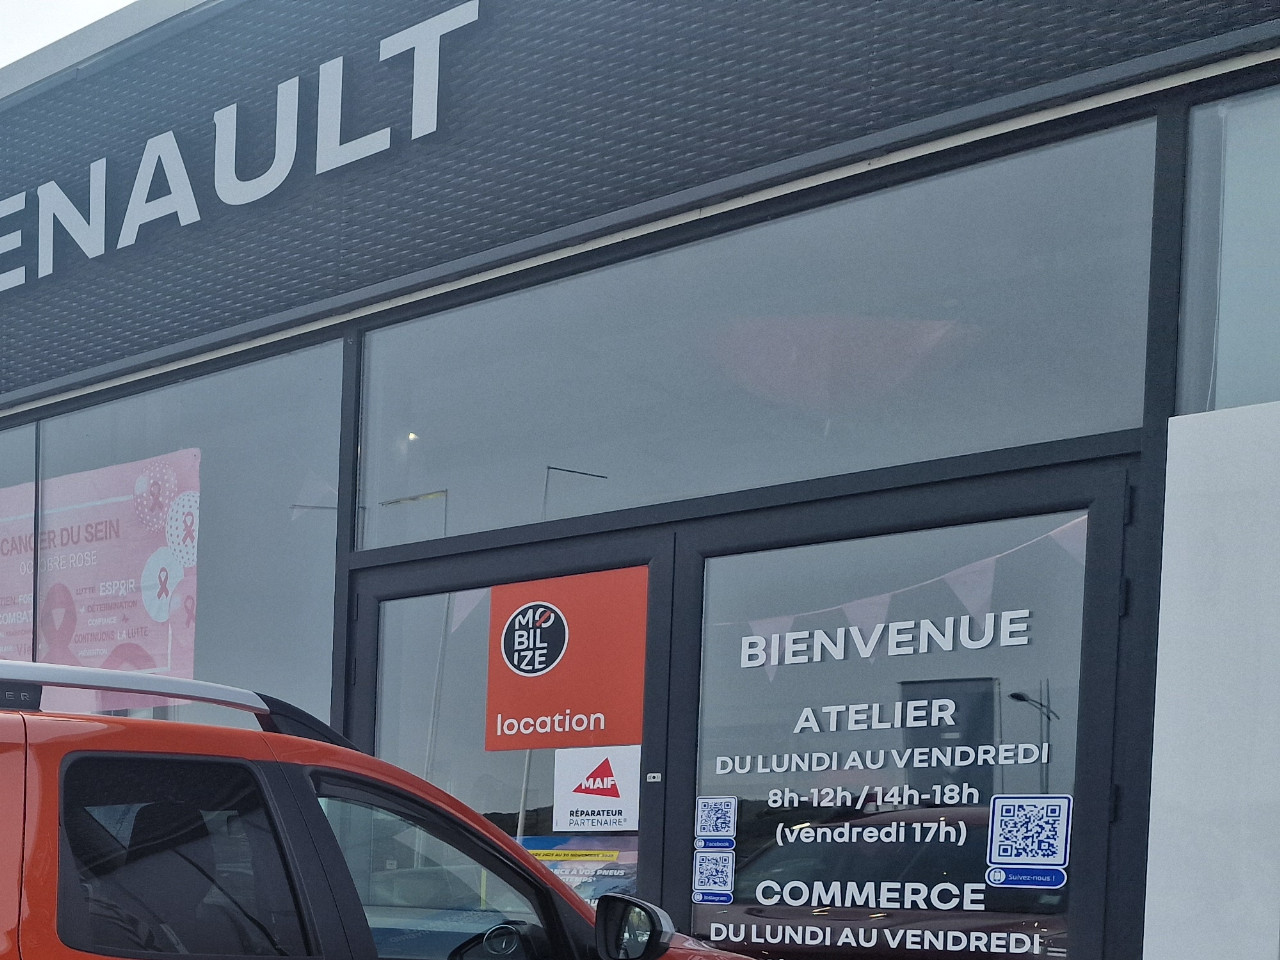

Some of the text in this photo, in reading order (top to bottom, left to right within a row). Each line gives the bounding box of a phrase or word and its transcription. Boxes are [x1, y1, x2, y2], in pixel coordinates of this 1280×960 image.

[60, 525, 81, 547] DU
[84, 518, 120, 543] SEIN
[20, 551, 97, 576] OCOBRE ROSE
[515, 608, 555, 629] MO
[514, 628, 548, 650] BIL
[740, 609, 1030, 668] BIENVENUE
[513, 649, 548, 670] IZE
[497, 709, 605, 736] location
[792, 698, 957, 734] ATELIER
[715, 742, 1050, 774] DU LUNDI AU VENDREDI
[581, 776, 617, 790] MAIF
[767, 787, 853, 809] 8h-12h
[873, 783, 980, 807] 14h-18h
[569, 808, 623, 818] RÉPARATEUR
[775, 820, 967, 847] (vendredi 17h)
[596, 869, 625, 877] PNEUS
[755, 880, 987, 911] COMMERCE
[709, 922, 1041, 955] DU LUNDI AU VENDREDI
